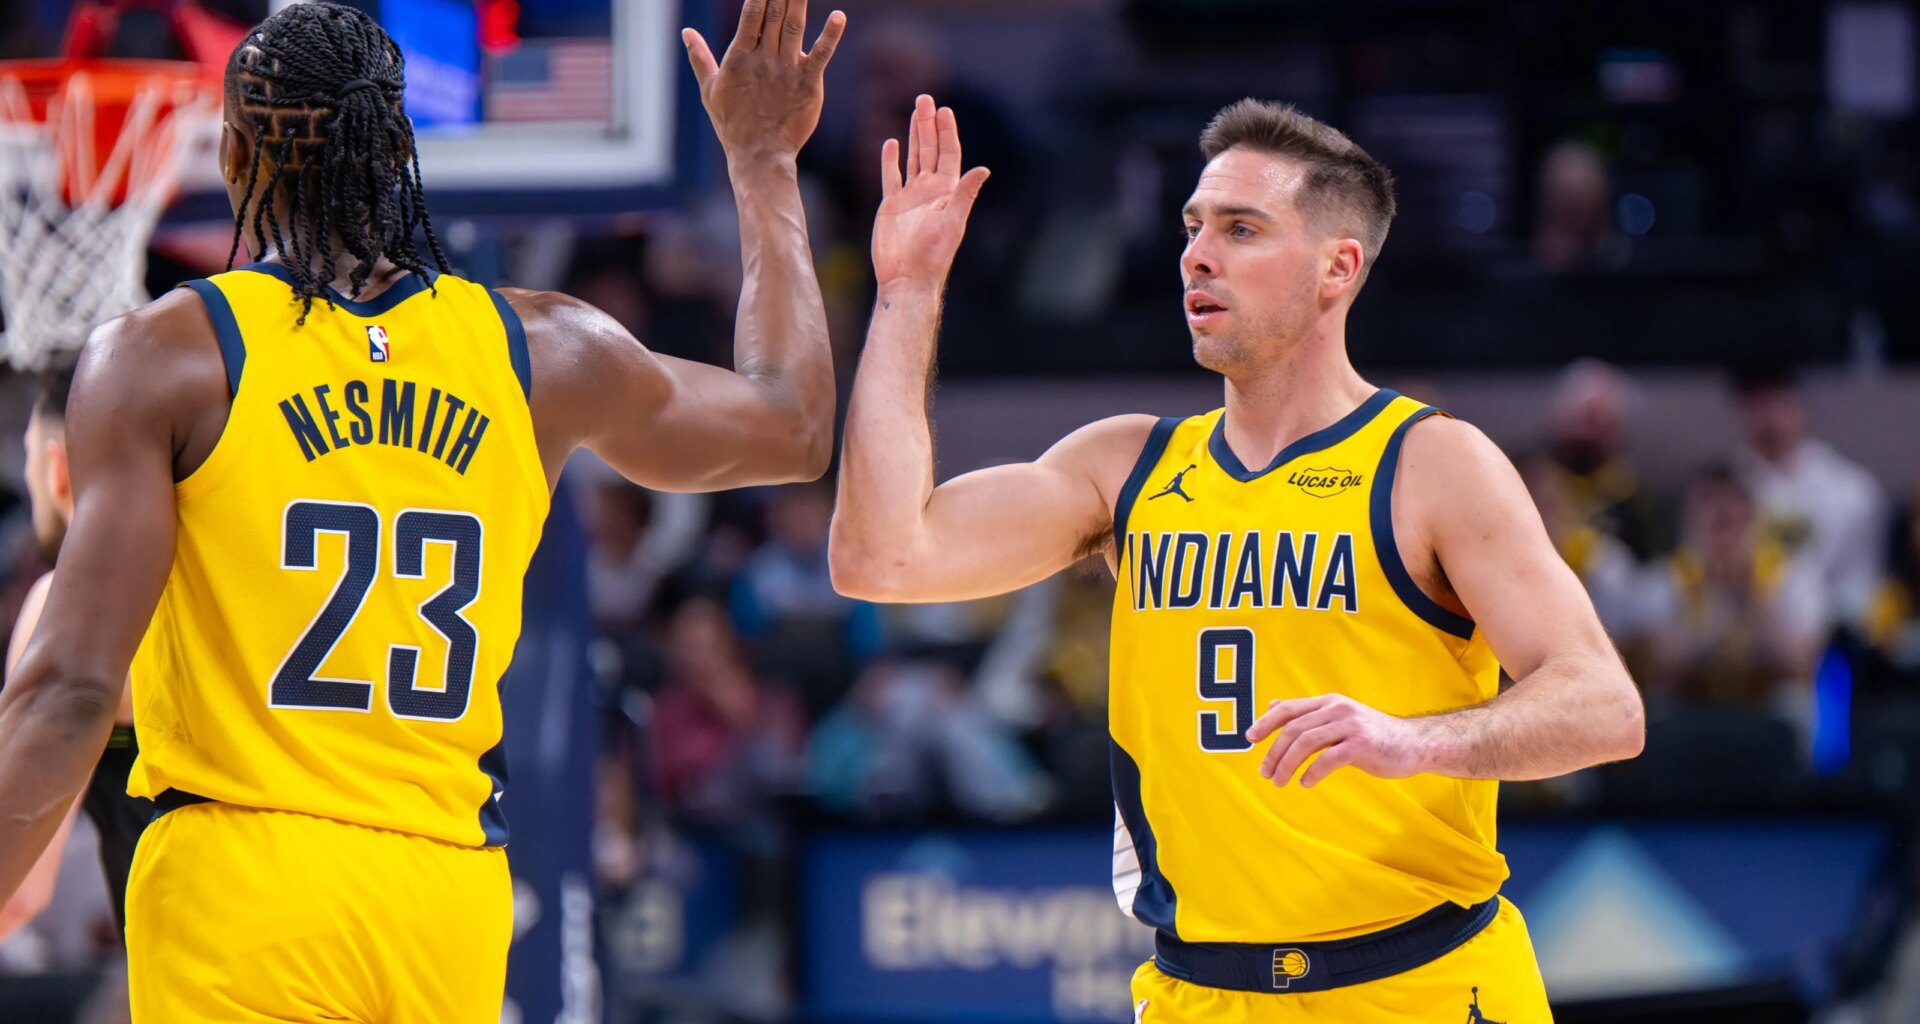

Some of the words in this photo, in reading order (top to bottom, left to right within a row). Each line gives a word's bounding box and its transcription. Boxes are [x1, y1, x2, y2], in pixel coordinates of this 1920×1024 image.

[278, 378, 490, 476] NESMITH
[1287, 472, 1339, 488] LUCAS
[1340, 474, 1363, 488] OIL
[267, 498, 484, 723] 23
[1128, 529, 1359, 614] INDIANA
[1196, 625, 1256, 753] 9
